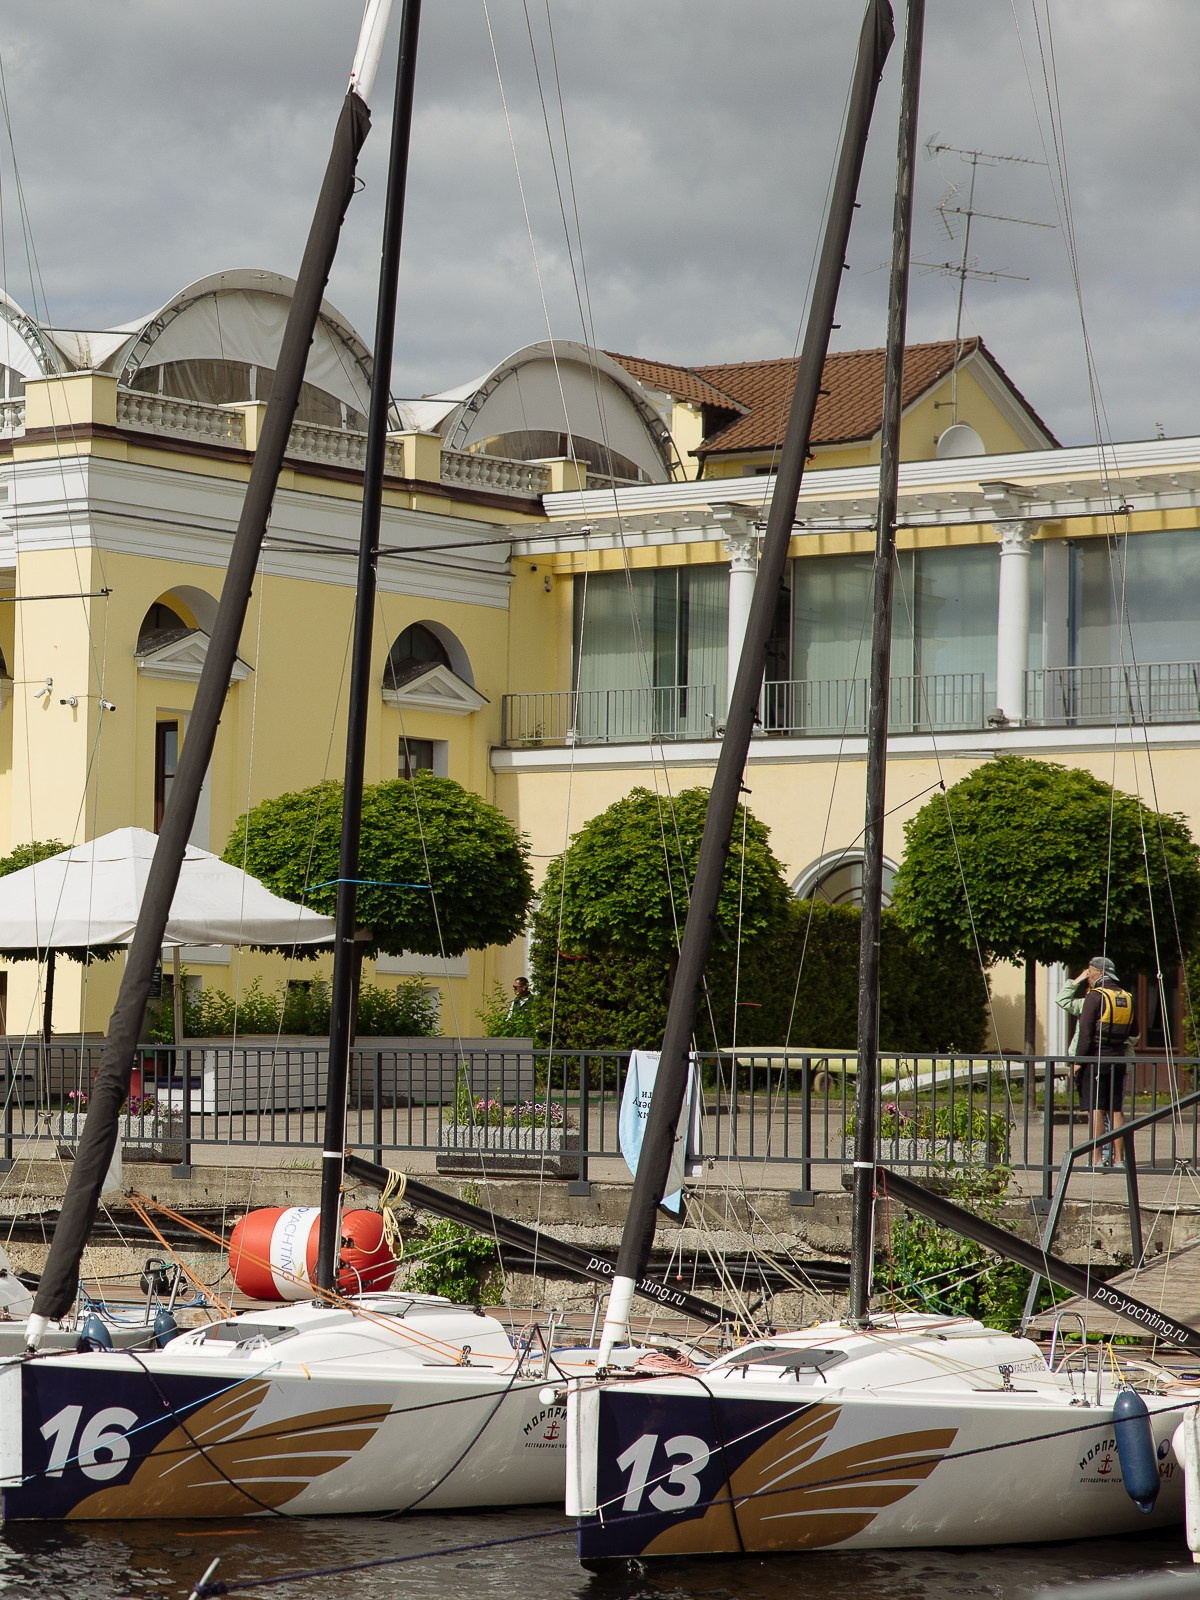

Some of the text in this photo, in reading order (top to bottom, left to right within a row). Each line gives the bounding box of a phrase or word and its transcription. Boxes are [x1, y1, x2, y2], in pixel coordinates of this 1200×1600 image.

[1092, 1287, 1189, 1343] pro-yachting.ru
[39, 1404, 139, 1481] 16
[523, 1406, 568, 1436] МОРПРИ
[616, 1433, 710, 1515] 13
[1079, 1439, 1119, 1471] МОРПР
